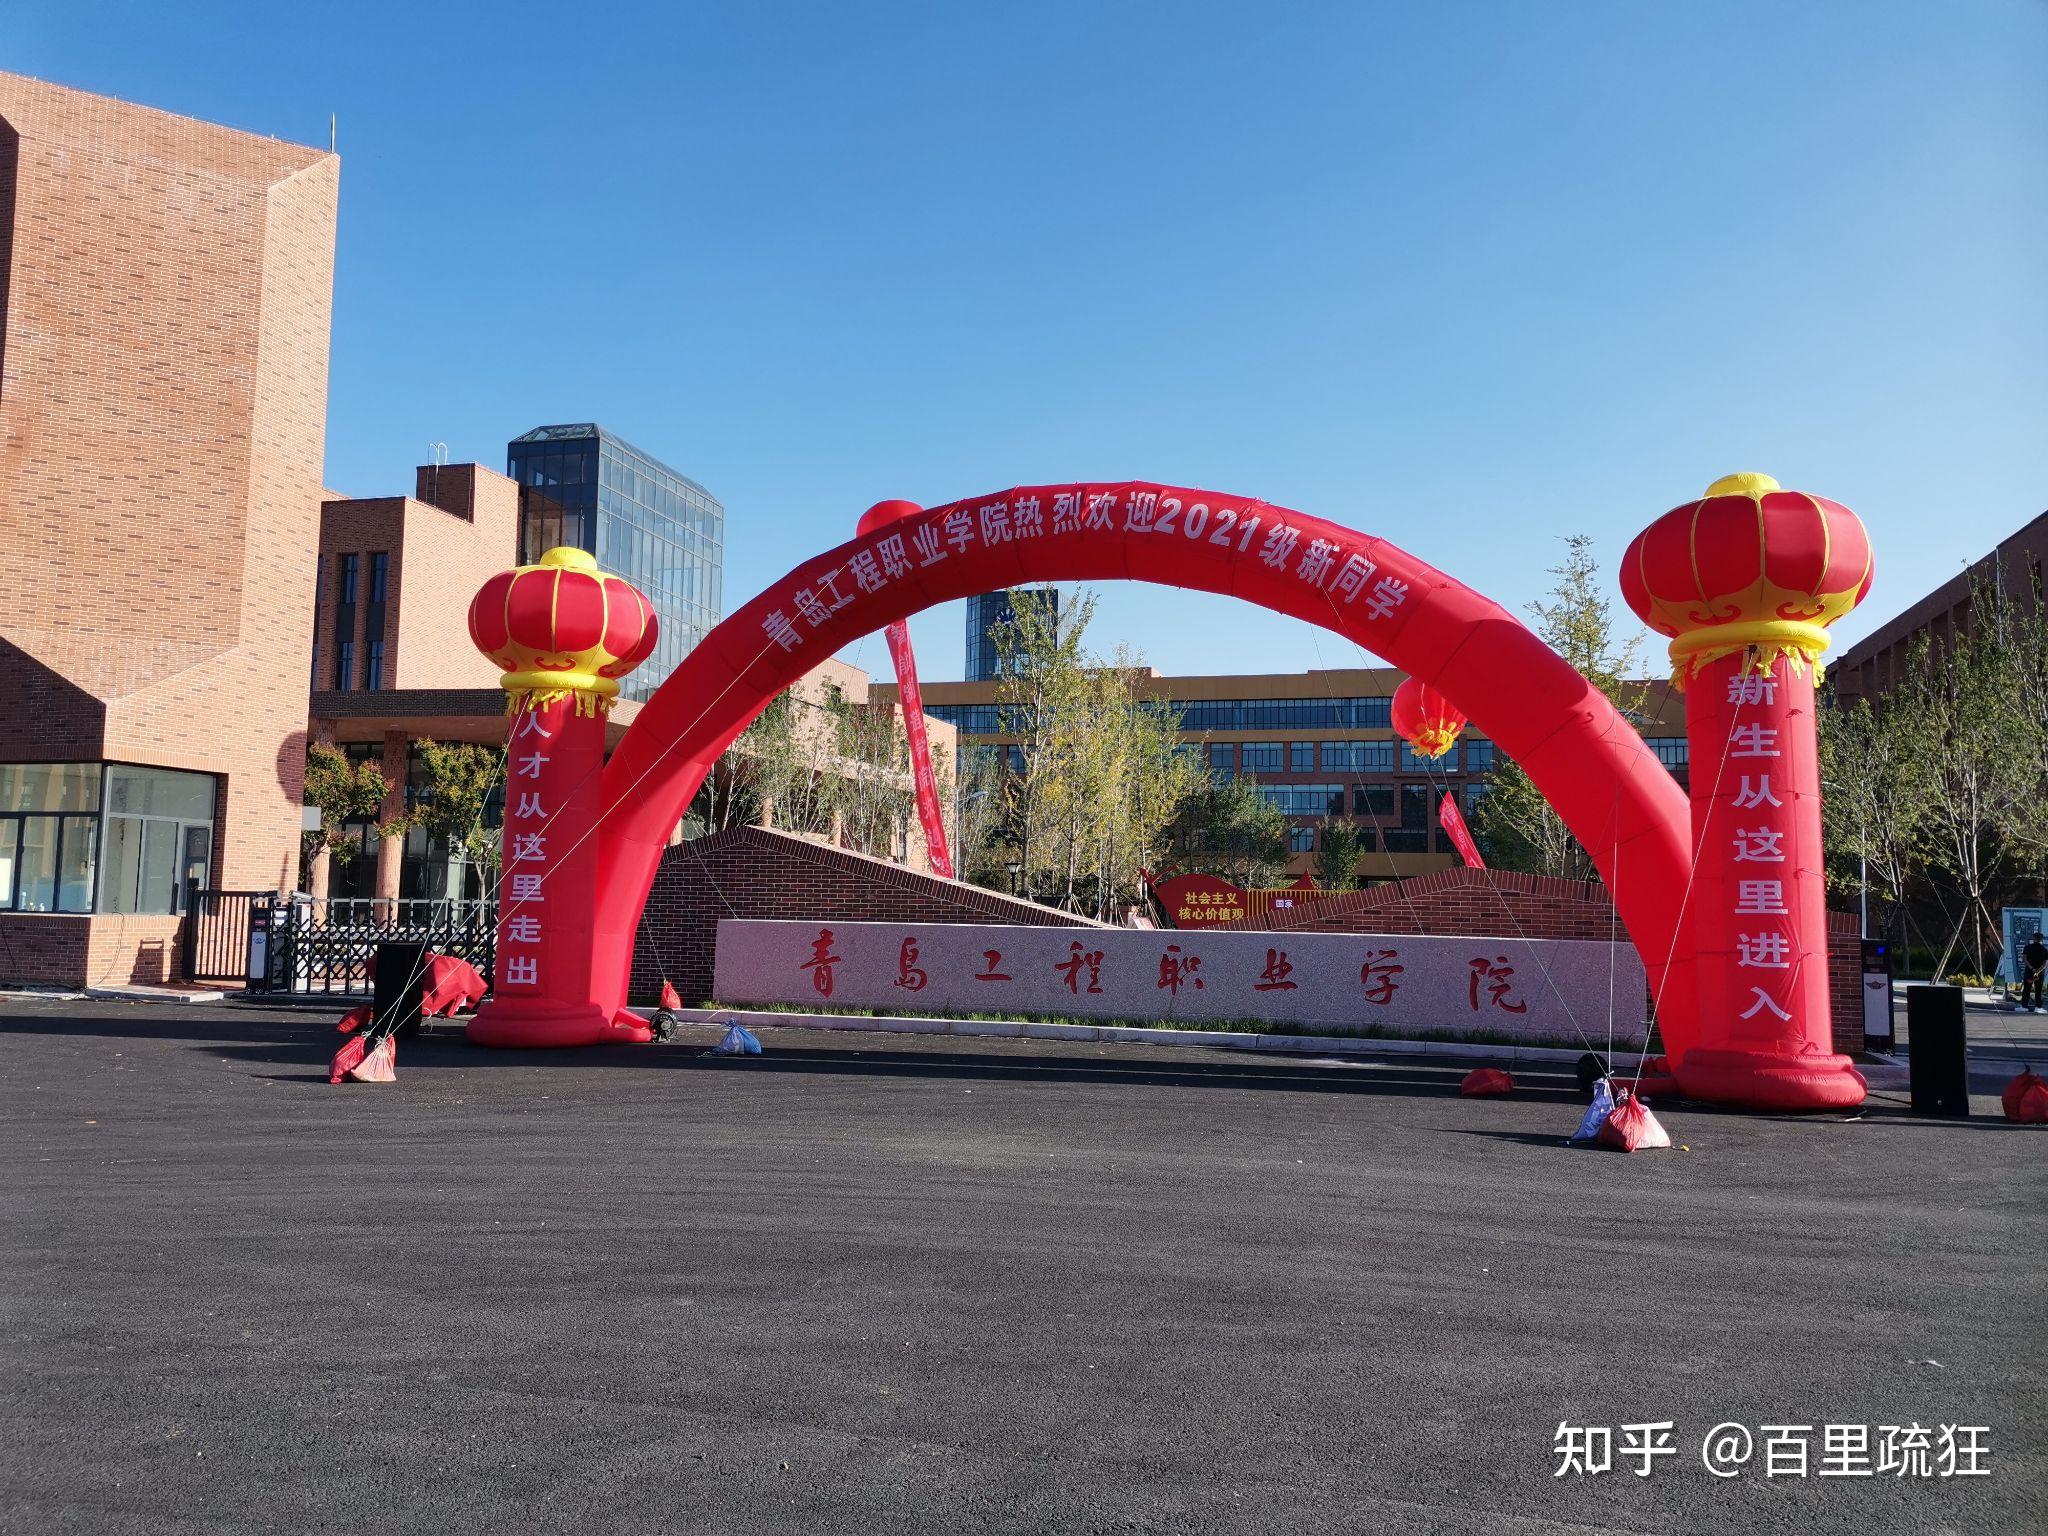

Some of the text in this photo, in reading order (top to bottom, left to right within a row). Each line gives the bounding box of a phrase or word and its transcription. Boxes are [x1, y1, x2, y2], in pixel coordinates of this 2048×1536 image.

[760, 491, 1409, 653] 青岛工程职业学院热烈欢迎2021级新同学
[506, 711, 552, 985] 人才从这里走出
[1185, 891, 1238, 905] 社会主义
[1726, 672, 1792, 1022] 新生从这里进入
[800, 928, 1527, 1013] 青岛工程职业学院
[1179, 907, 1244, 921] 核心价值观
